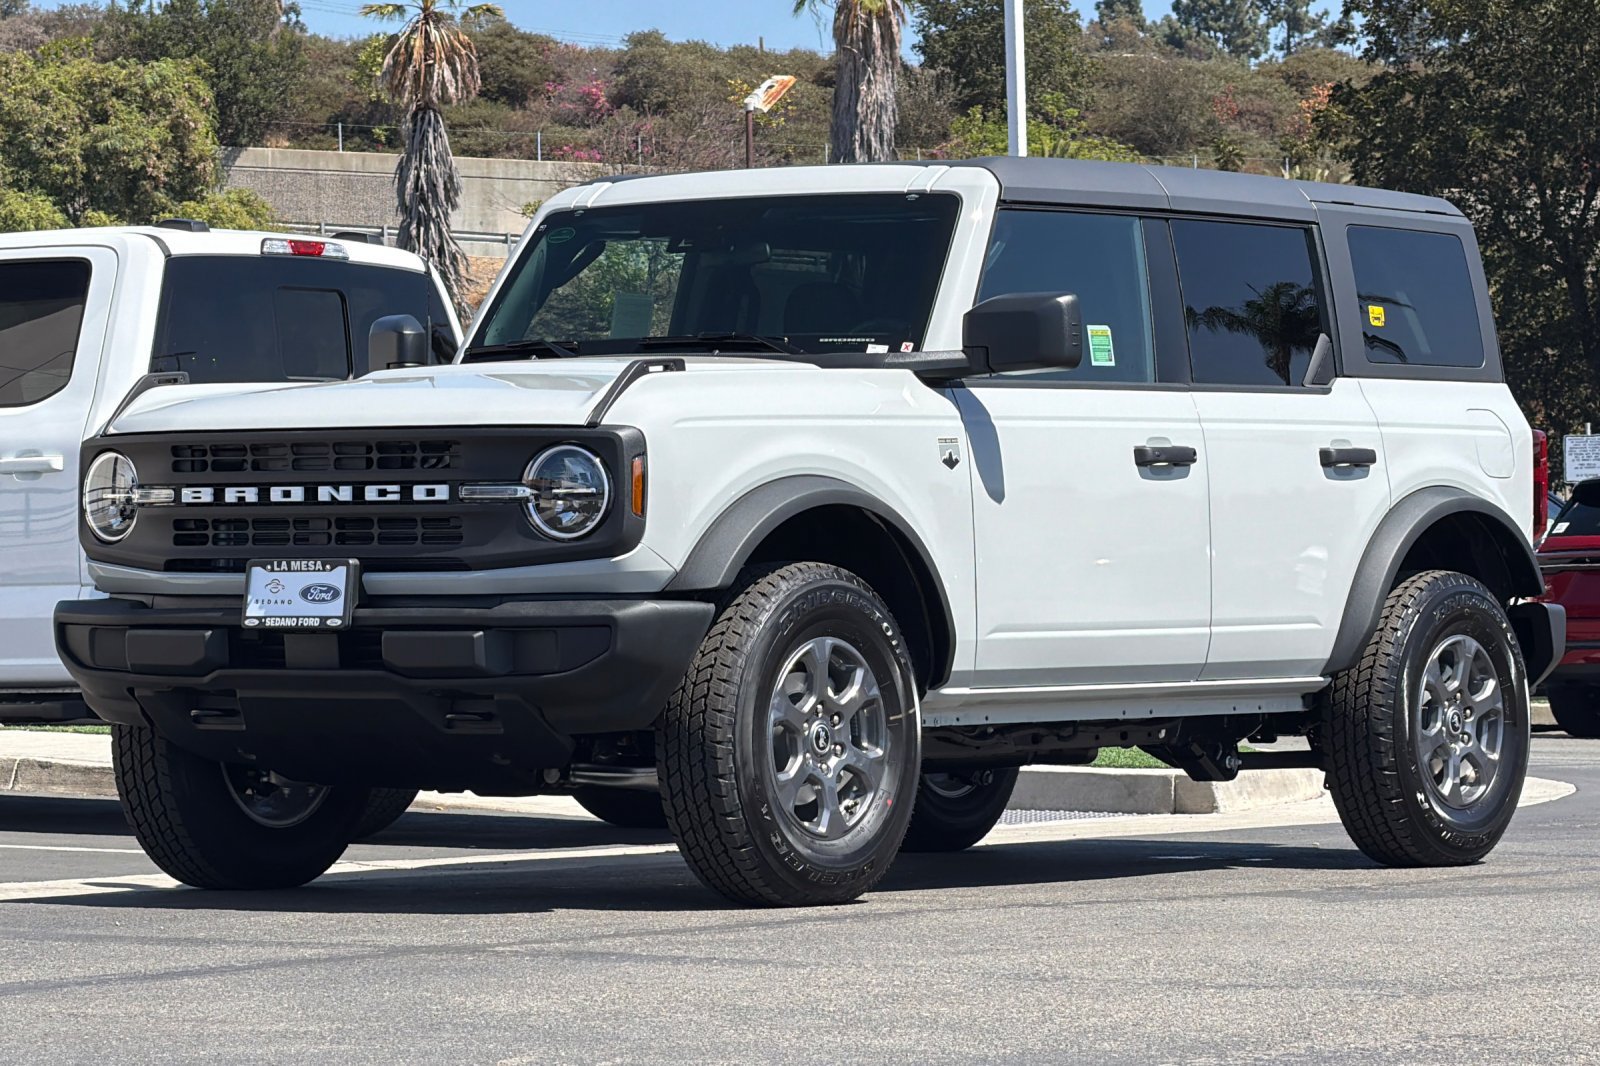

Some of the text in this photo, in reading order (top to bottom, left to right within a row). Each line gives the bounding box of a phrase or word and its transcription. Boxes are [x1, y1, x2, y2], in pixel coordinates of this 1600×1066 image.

[181, 485, 450, 503] BRONCO
[273, 561, 323, 571] LA MESA
[307, 585, 333, 601] Ford
[265, 618, 297, 627] SEDANO
[298, 617, 320, 627] FORD
